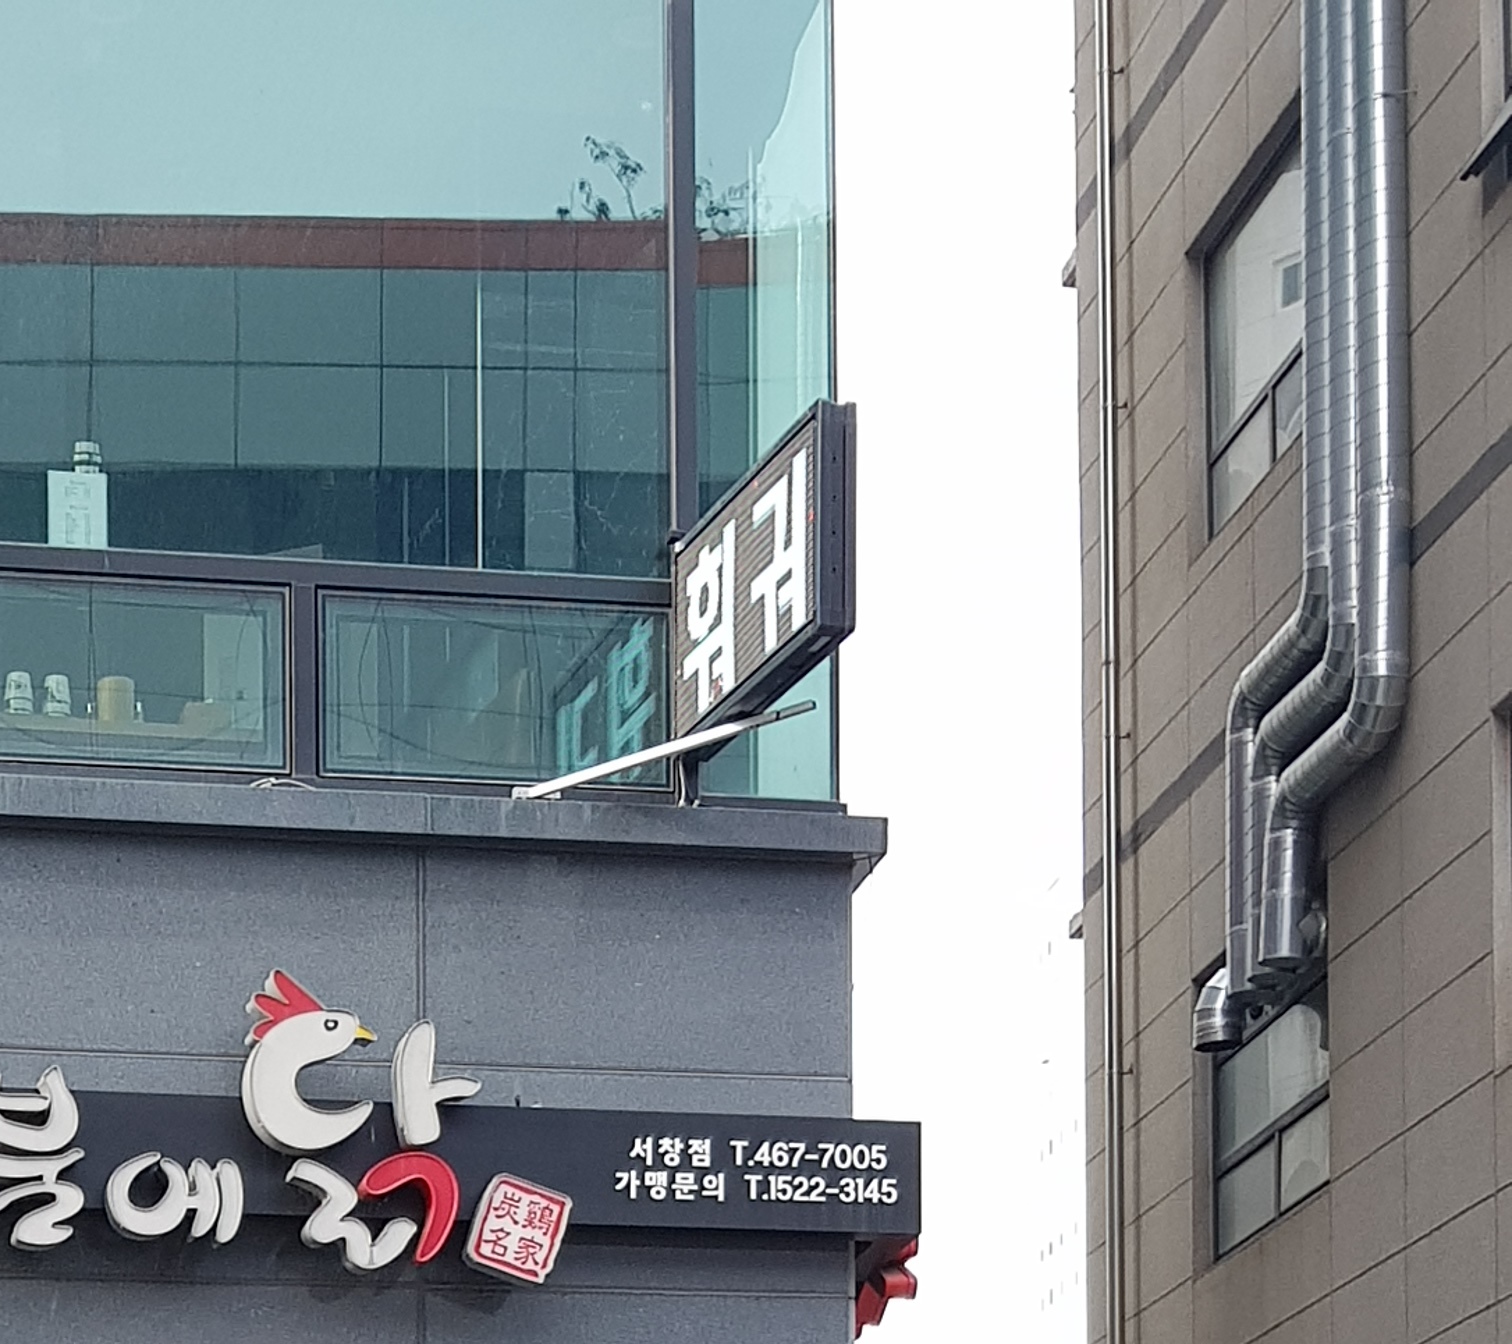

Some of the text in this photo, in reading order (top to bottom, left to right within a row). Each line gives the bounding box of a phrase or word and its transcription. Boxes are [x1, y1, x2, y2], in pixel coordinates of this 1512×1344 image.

[629, 1137, 888, 1170] 서창점 T.467-7005
[614, 1170, 898, 1205] 가맹문의 T.1522-3145
